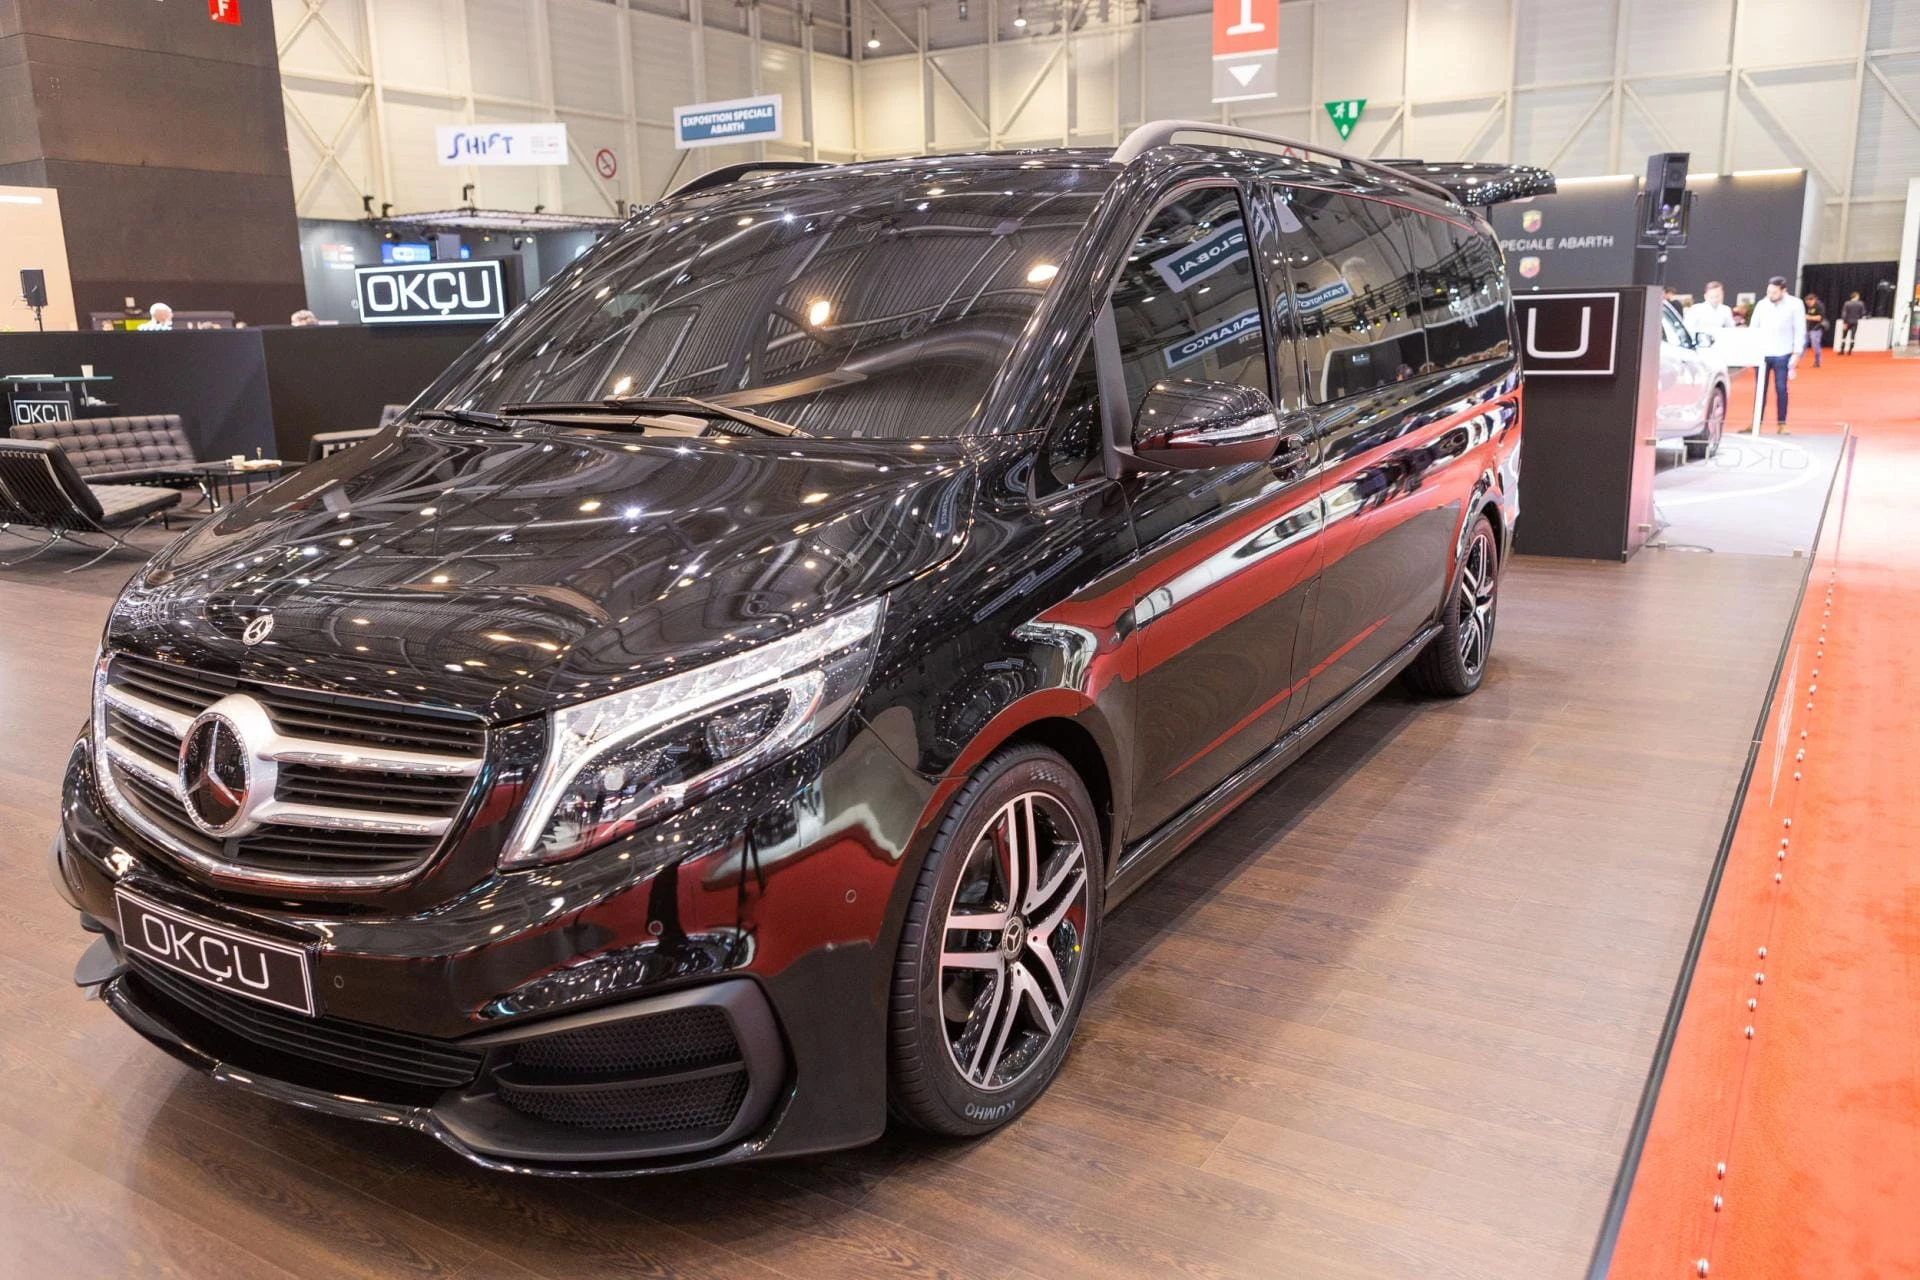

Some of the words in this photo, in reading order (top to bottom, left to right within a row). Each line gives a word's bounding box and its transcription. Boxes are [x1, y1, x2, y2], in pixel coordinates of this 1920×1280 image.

[682, 112, 732, 127] EXPOSITION
[733, 107, 773, 121] SPECIALE
[710, 122, 746, 135] ABARTH
[1558, 235, 1614, 249] ABARTH
[366, 270, 491, 316] OKÇU
[141, 913, 270, 990] OKÇU
[964, 1100, 1016, 1120] KUMHO
